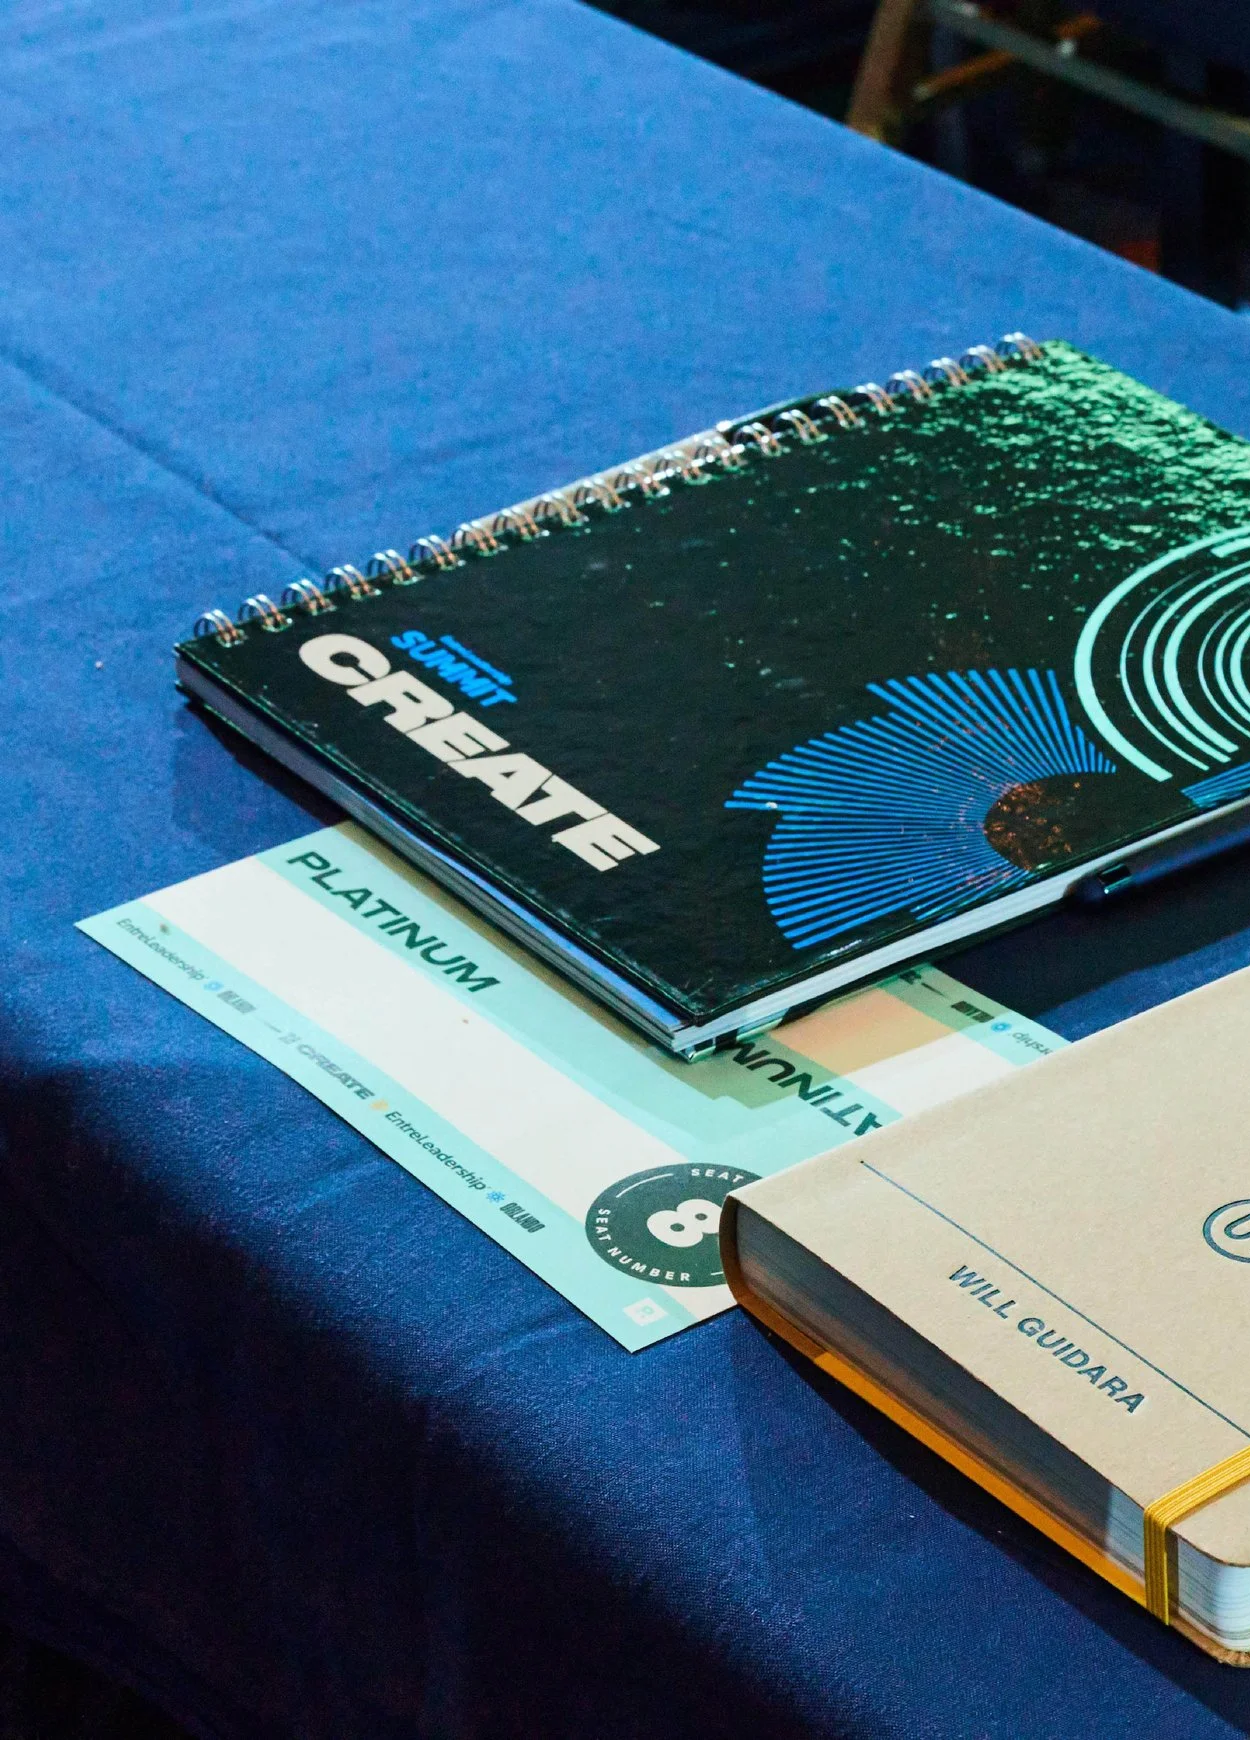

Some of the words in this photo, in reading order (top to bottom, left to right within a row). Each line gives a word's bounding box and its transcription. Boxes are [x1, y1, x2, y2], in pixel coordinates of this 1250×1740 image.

[390, 629, 518, 708] SUMMIT
[299, 633, 661, 872] CREATE
[286, 850, 501, 994] PLATINUM
[296, 1042, 375, 1100] CREATE
[385, 1110, 488, 1191] EntreLeadership
[646, 1199, 723, 1248] 8
[691, 1168, 744, 1183] SEAT
[595, 1208, 612, 1242] SEAT
[607, 1246, 691, 1282] NUMBER
[948, 1264, 1017, 1320] WILL
[1017, 1316, 1146, 1414] GUIDARA
